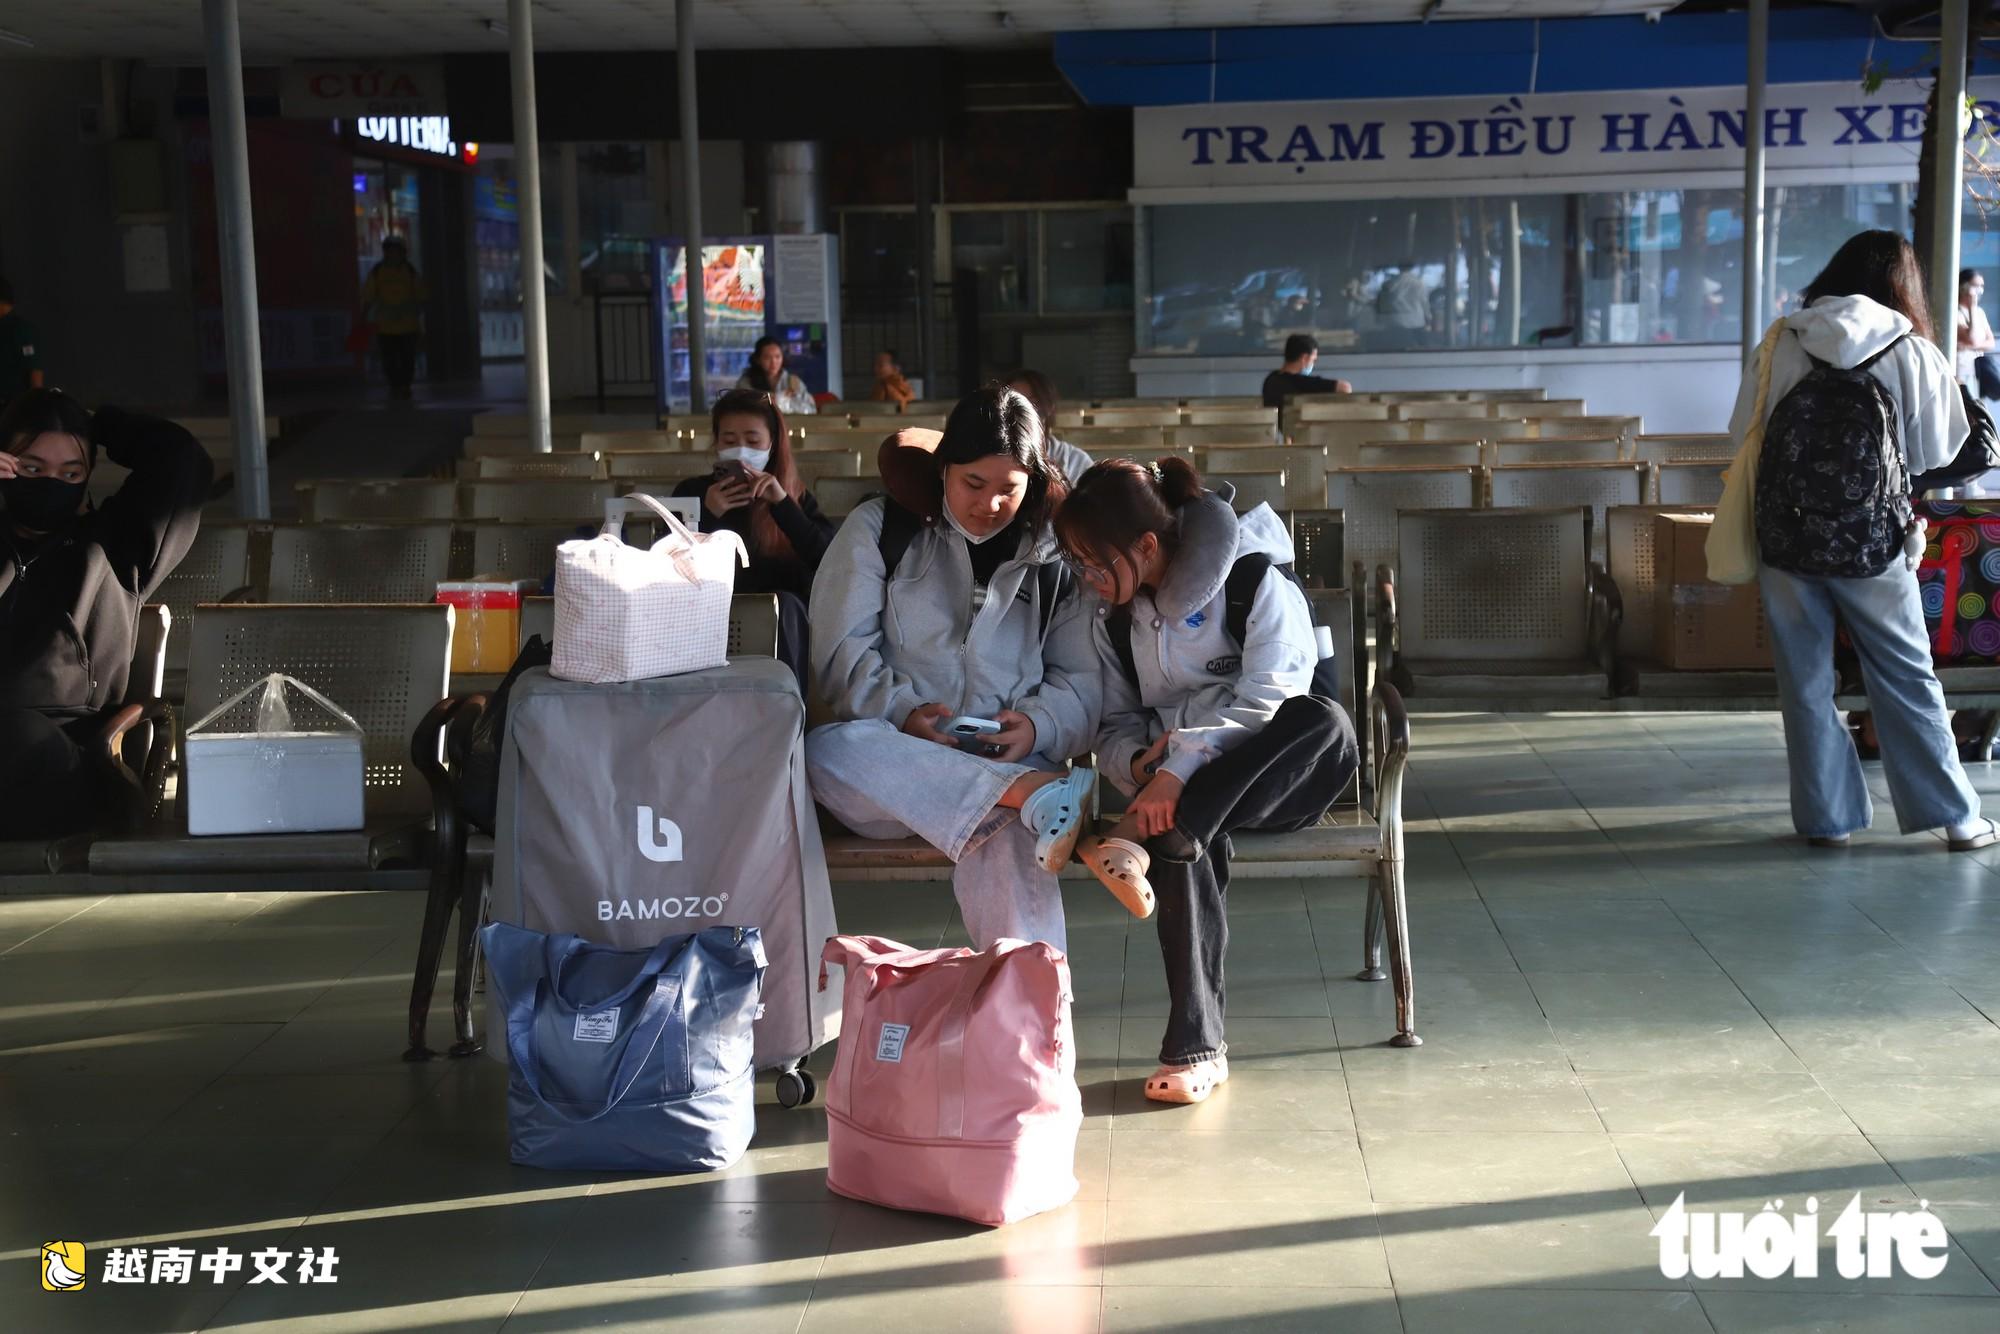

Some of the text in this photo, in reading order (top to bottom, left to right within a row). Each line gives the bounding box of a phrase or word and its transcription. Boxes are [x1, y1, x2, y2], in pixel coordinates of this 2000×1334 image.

[1182, 122, 1386, 174] TRẠM
[1409, 97, 1576, 158] ĐIỀU
[1600, 96, 1808, 153] HÀNH
[1834, 104, 1928, 146] XE
